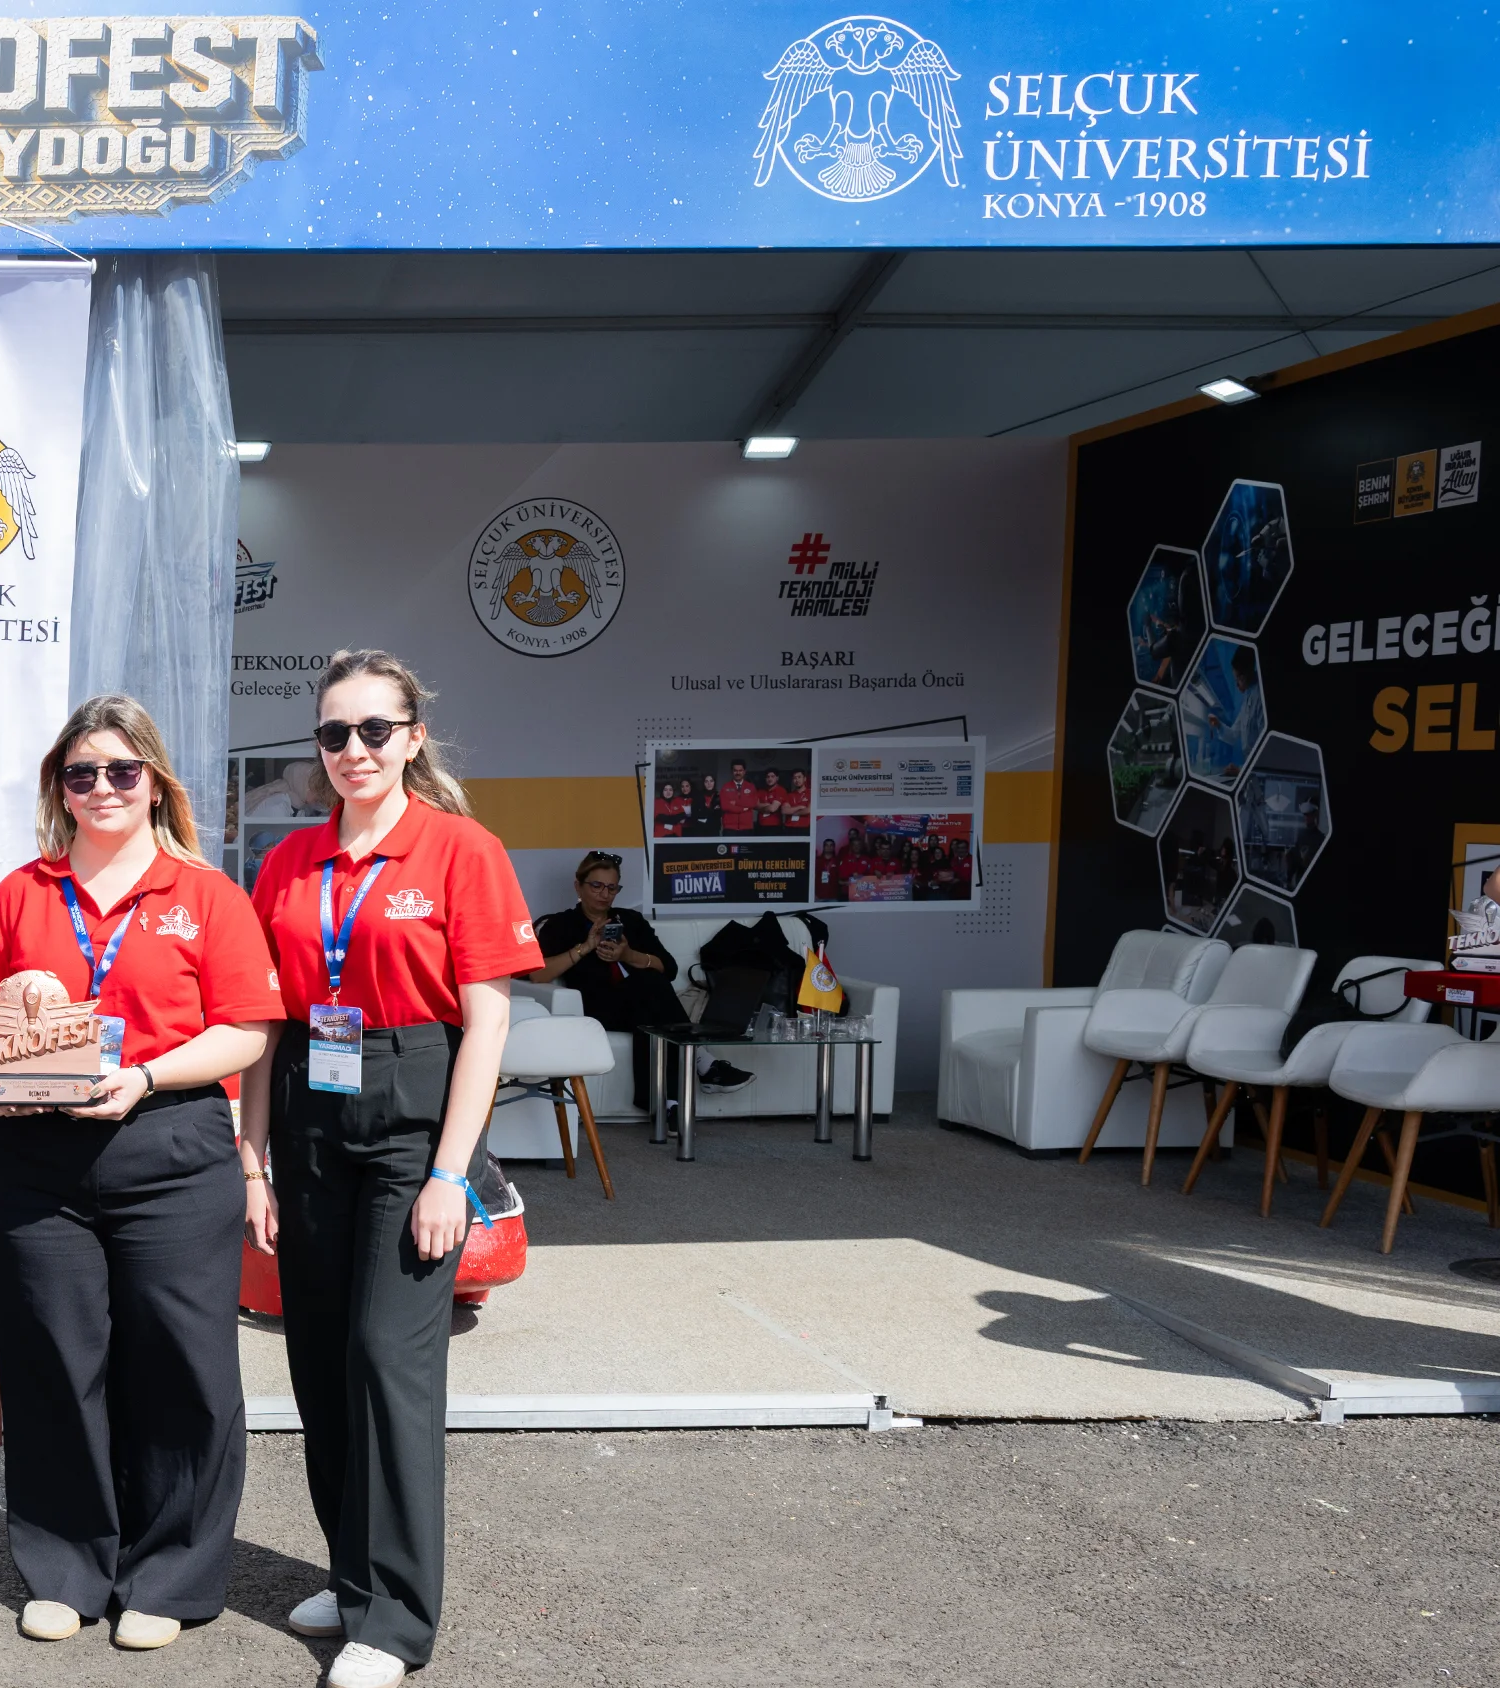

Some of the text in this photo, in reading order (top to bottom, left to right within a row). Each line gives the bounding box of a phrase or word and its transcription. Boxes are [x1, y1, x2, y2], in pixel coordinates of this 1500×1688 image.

[984, 69, 1200, 127] SELÇUK
[982, 128, 1373, 183] ÜNİVERSİTESİ
[981, 191, 1107, 219] KONYA
[1134, 190, 1207, 218] 1908
[474, 501, 620, 590] SELÇUK ÜNİVERSİTESİ
[506, 627, 550, 648] KONYA
[560, 626, 588, 646] 1908
[231, 655, 332, 672] TEKNOLOJ
[780, 650, 856, 670] BAŞARI
[231, 680, 301, 700] Geleceğe
[670, 669, 965, 692] Ulusal ve Uluslararası Başarıda Öncü
[1368, 682, 1498, 754] SEL
[821, 774, 847, 783] SELÇUK
[665, 864, 689, 874] SELÇUK
[738, 857, 806, 870] DÜNYA GENELİNDE
[674, 874, 723, 895] DÜNYA
[384, 905, 434, 919] TEKNOFEST
[1447, 929, 1500, 952] TEKNO
